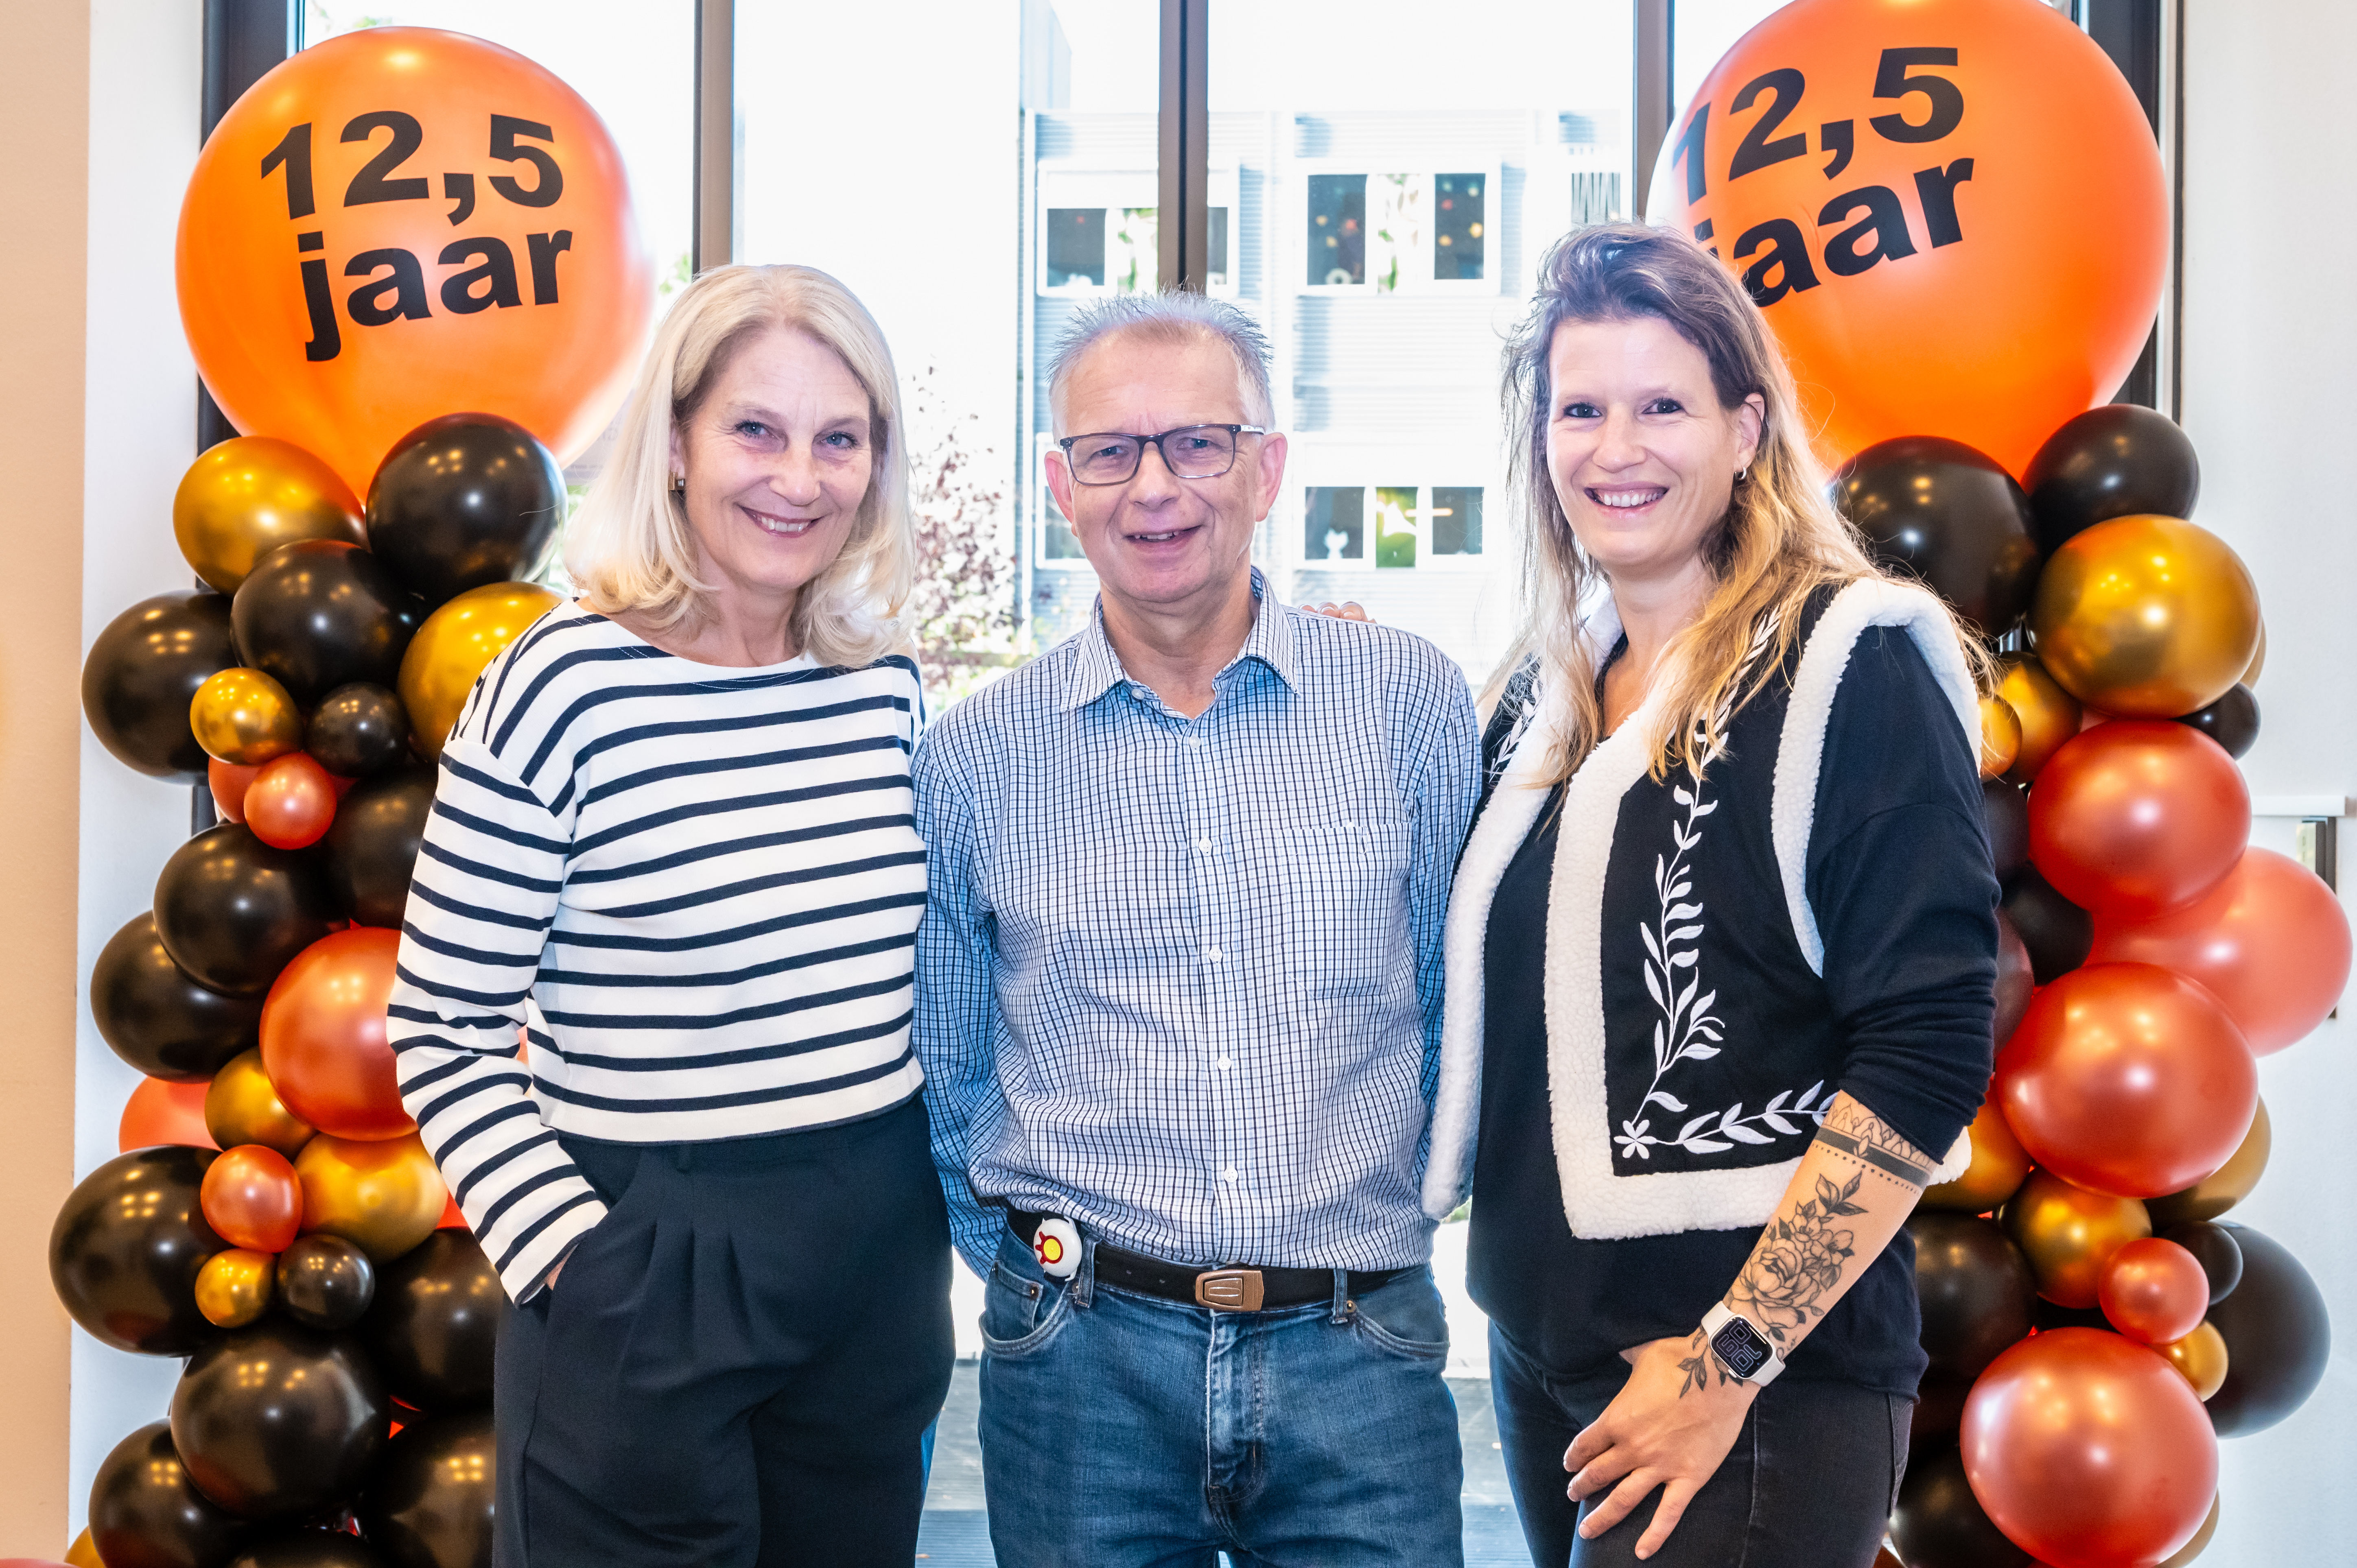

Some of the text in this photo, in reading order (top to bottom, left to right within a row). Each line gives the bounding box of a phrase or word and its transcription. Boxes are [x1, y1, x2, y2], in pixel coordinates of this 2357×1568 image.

[261, 111, 563, 226] 12,5
[1672, 47, 1964, 206] 12,5
[297, 229, 573, 362] jaar
